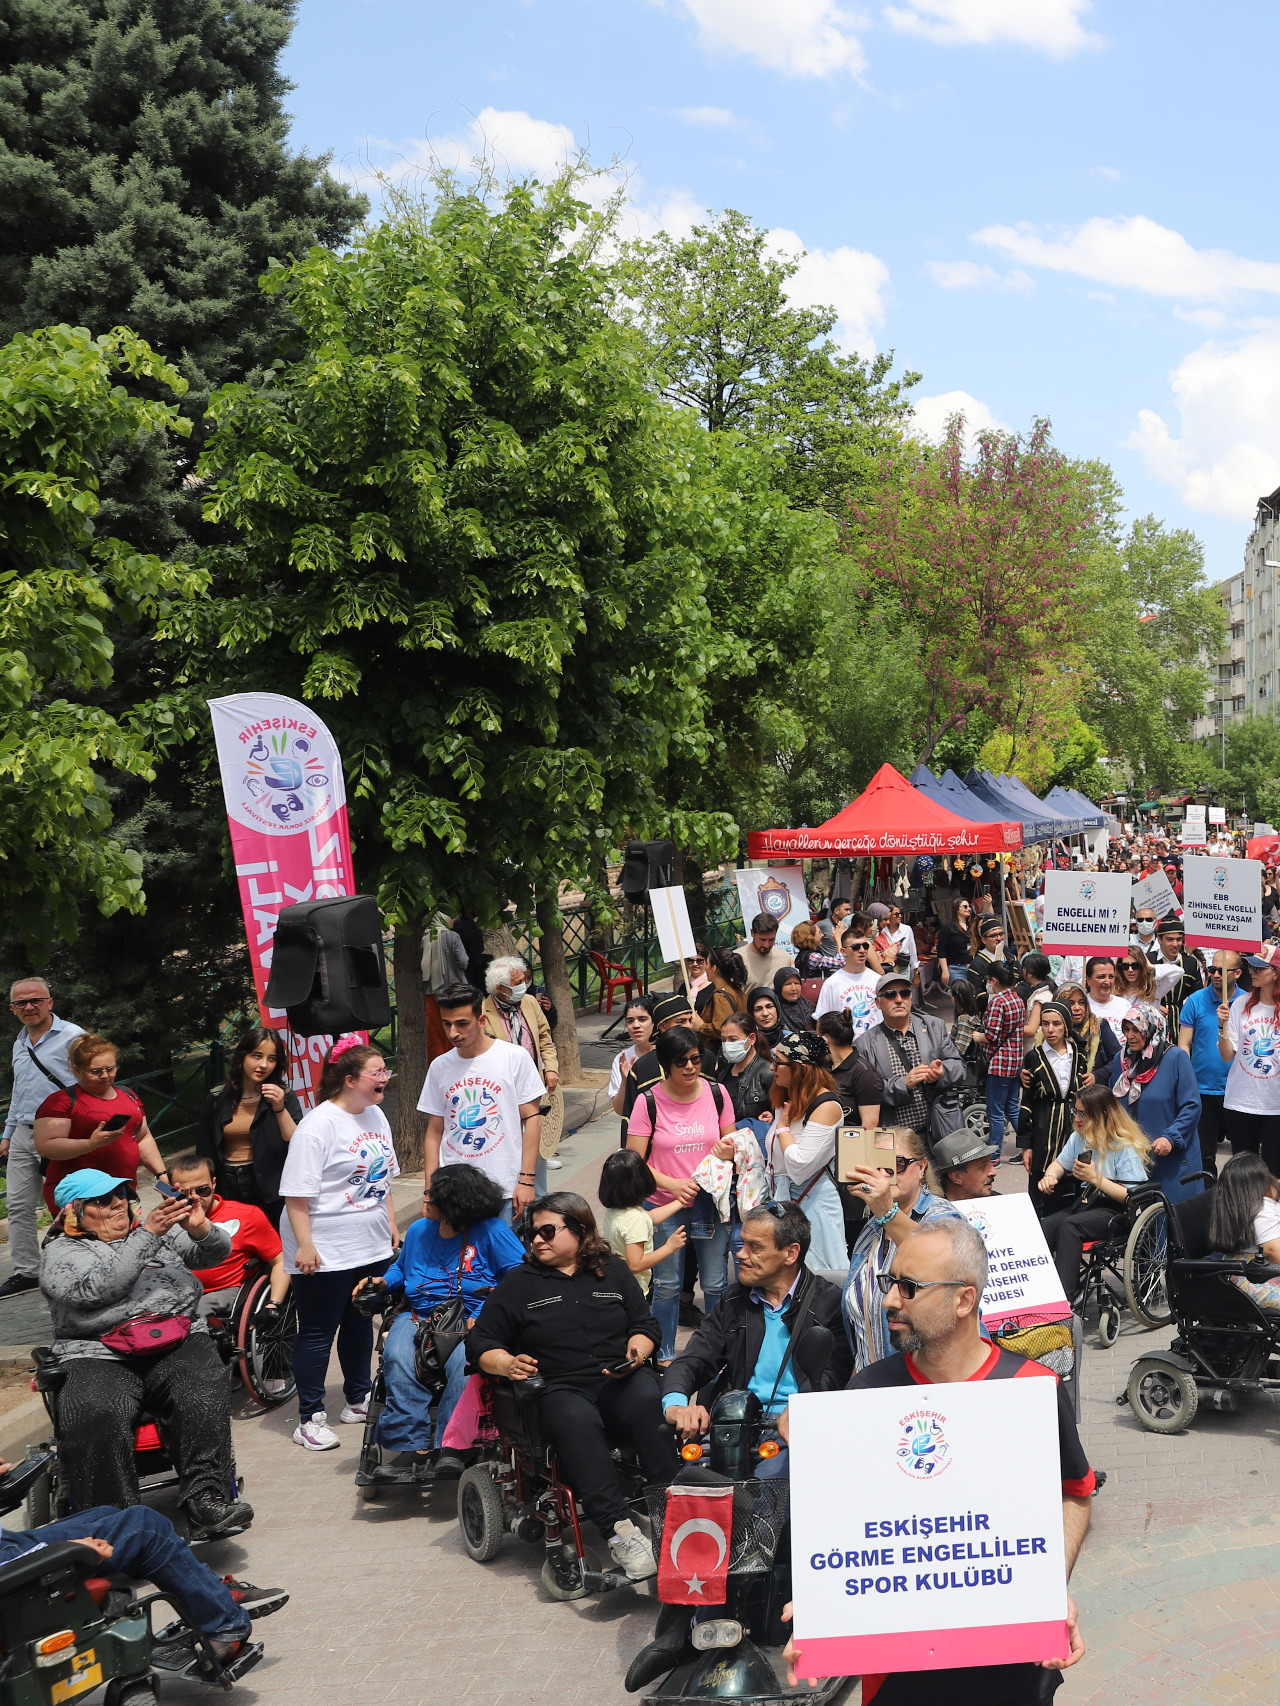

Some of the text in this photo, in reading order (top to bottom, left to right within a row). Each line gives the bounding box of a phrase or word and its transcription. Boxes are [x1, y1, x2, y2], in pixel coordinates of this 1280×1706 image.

[761, 833, 833, 855] Hayallerin
[834, 834, 876, 855] gerçeğe
[879, 831, 945, 853] dönüştüğü
[947, 829, 980, 850] şehir
[1213, 893, 1229, 901] EBB
[1057, 906, 1117, 919] ENGELLİ Mİ ?
[1187, 901, 1256, 914] ZİHİNSEL ENGELLİ
[1192, 911, 1252, 923] GÜNDÜZ YAŞAM
[1045, 922, 1128, 934] ENGELLENEN Mİ ?
[1205, 922, 1239, 932] MERKEZİ
[445, 1077, 502, 1099] ESKİŞEHİR
[675, 1120, 705, 1136] Smile
[349, 1131, 391, 1154] ESKİŞEHİ
[674, 1142, 706, 1154] OUTFIT
[987, 1247, 1015, 1260] KİYE
[1000, 1255, 1049, 1272] DERNEĞİ
[983, 1272, 1030, 1289] KİŞEHİR
[982, 1286, 1025, 1305] ŞUBESİ
[898, 1409, 947, 1427] ESKİŞEHİR
[864, 1510, 990, 1539] ESKİŞEHİR
[810, 1536, 1047, 1570] GÖRME ENGELLİLER
[845, 1563, 1013, 1596] SPOR KULÜBÜ
